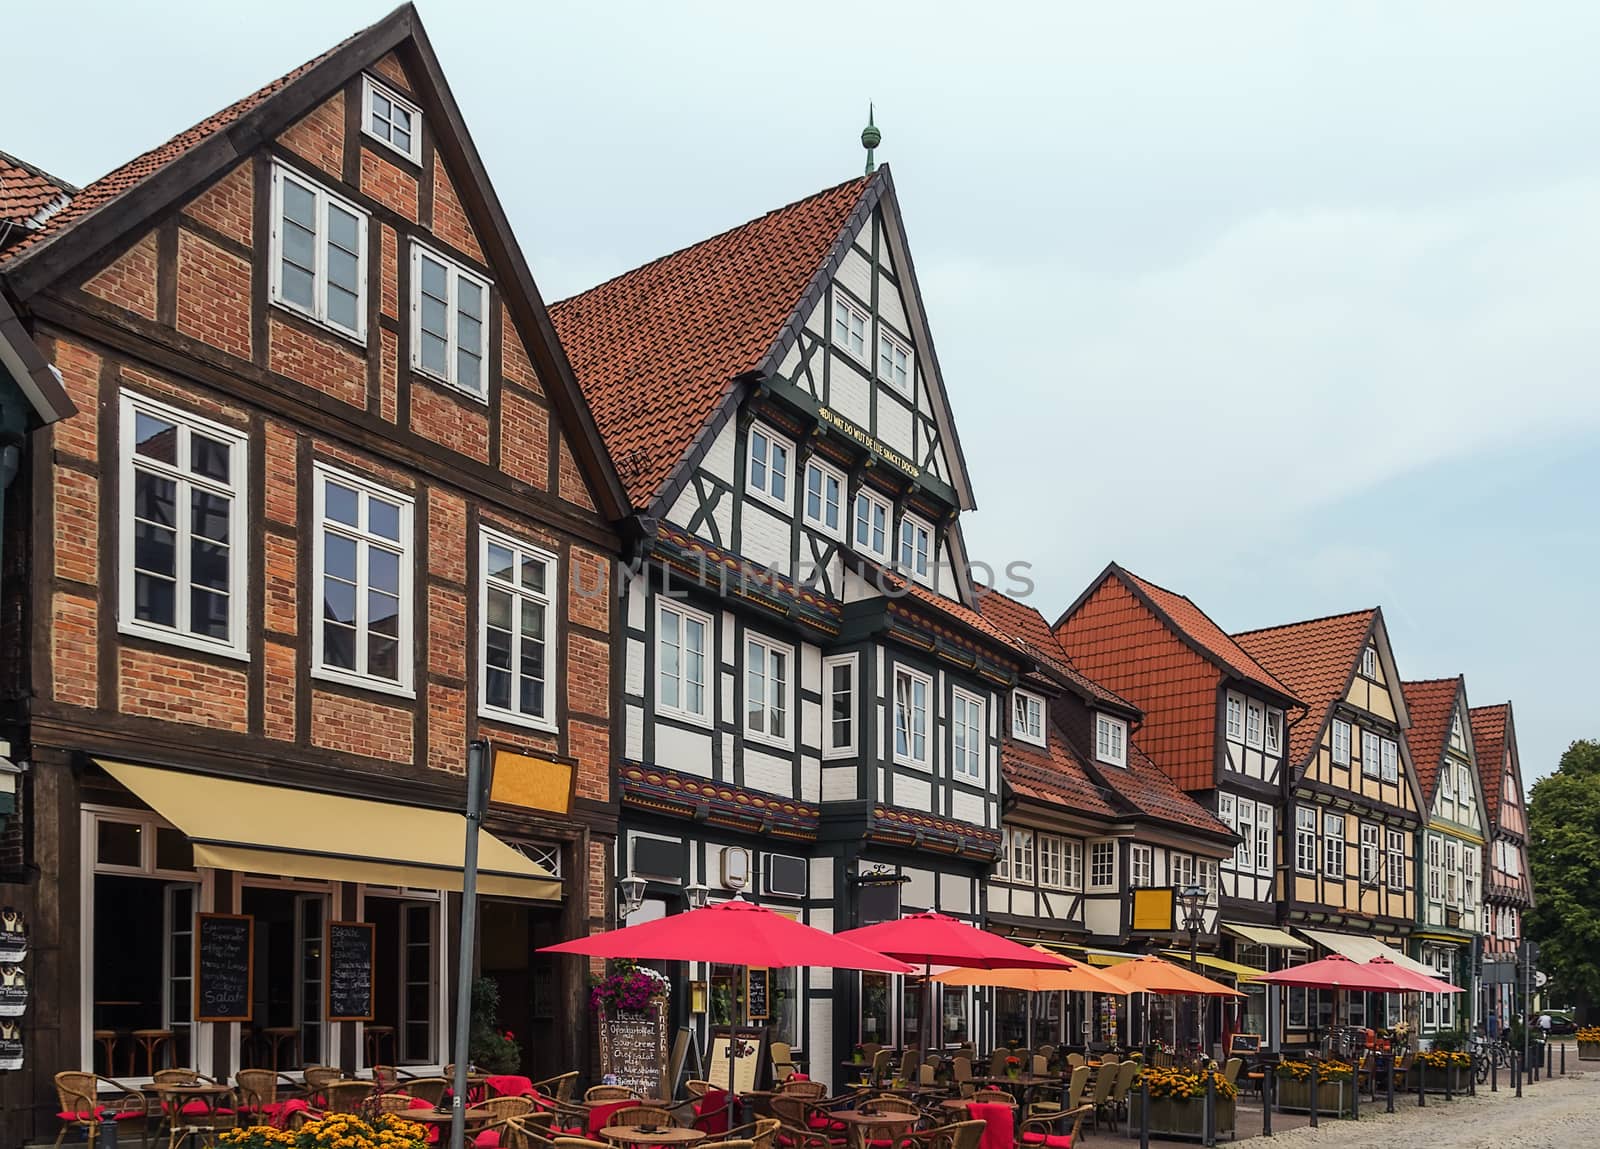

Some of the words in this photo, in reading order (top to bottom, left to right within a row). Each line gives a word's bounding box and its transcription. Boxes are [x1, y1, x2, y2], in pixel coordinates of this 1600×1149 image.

[845, 423, 853, 435] DO
[866, 436, 873, 449] DE
[616, 1009, 646, 1021] Heute
